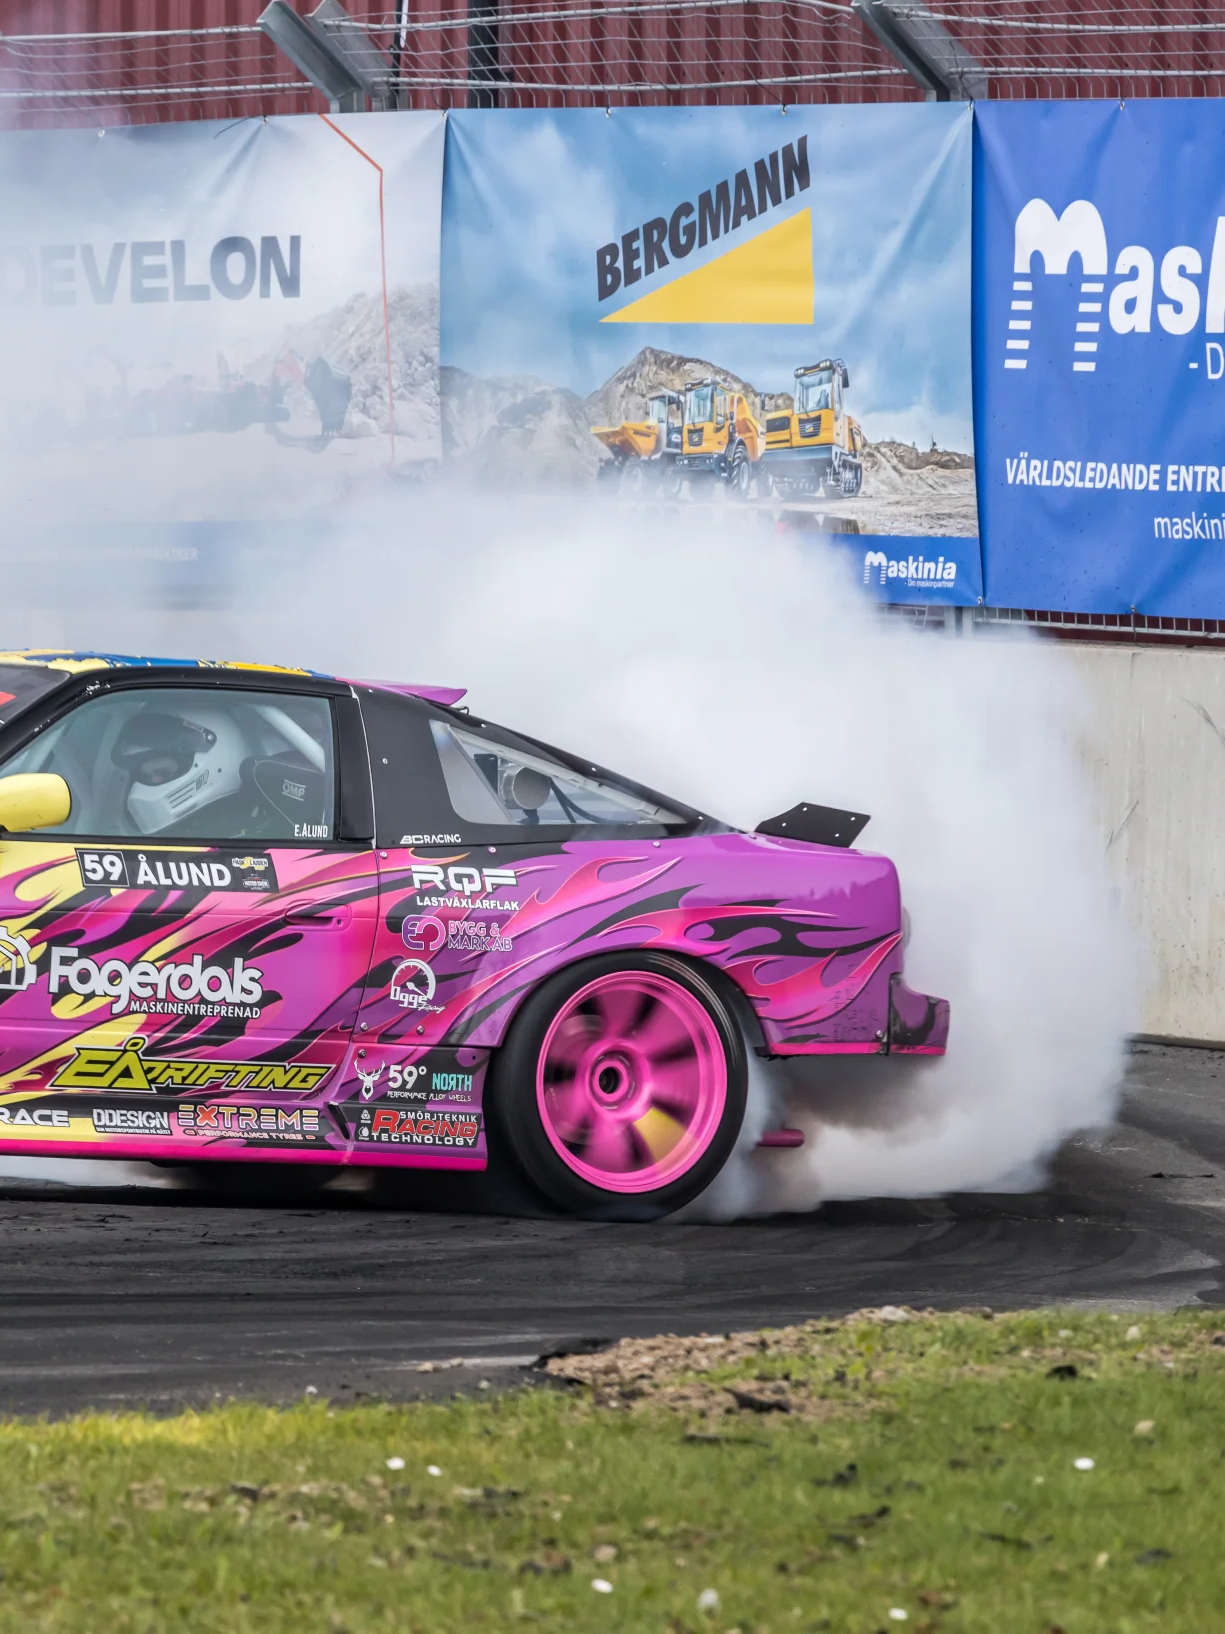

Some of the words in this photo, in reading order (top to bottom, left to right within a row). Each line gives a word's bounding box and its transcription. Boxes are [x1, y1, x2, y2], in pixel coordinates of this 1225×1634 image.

[596, 134, 811, 302] BERGMANN
[1006, 452, 1161, 491] VÄRLDSLEDANDE
[1166, 465, 1225, 493] ENTR
[863, 551, 957, 585] Maskinia
[282, 782, 306, 798] OMP
[83, 854, 125, 882] 59
[136, 853, 232, 887] ÅLUND
[410, 864, 518, 896] RQF
[416, 896, 520, 910] LASTVÄXLARFLAK
[448, 920, 486, 937] BYGG
[490, 922, 501, 937] &
[447, 935, 491, 951] MARK
[491, 937, 513, 952] AB
[48, 946, 264, 1015] Fagerdals
[129, 1000, 261, 1019] MASKINENTREPRENAD
[388, 1064, 427, 1090] 59°
[387, 1091, 427, 1100] PERFORMANCE
[429, 1092, 447, 1101] ALLOY
[449, 1093, 472, 1102] WHEELS
[92, 1108, 170, 1129] DDESIGN
[178, 1104, 320, 1131] EXTREME
[371, 1109, 478, 1139] RACING
[400, 1111, 477, 1123] SMÖRJTEKNIK
[198, 1130, 270, 1139] PERFORMANCE
[272, 1132, 304, 1140] TYRES
[371, 1132, 475, 1146] TECHNOLOGY
